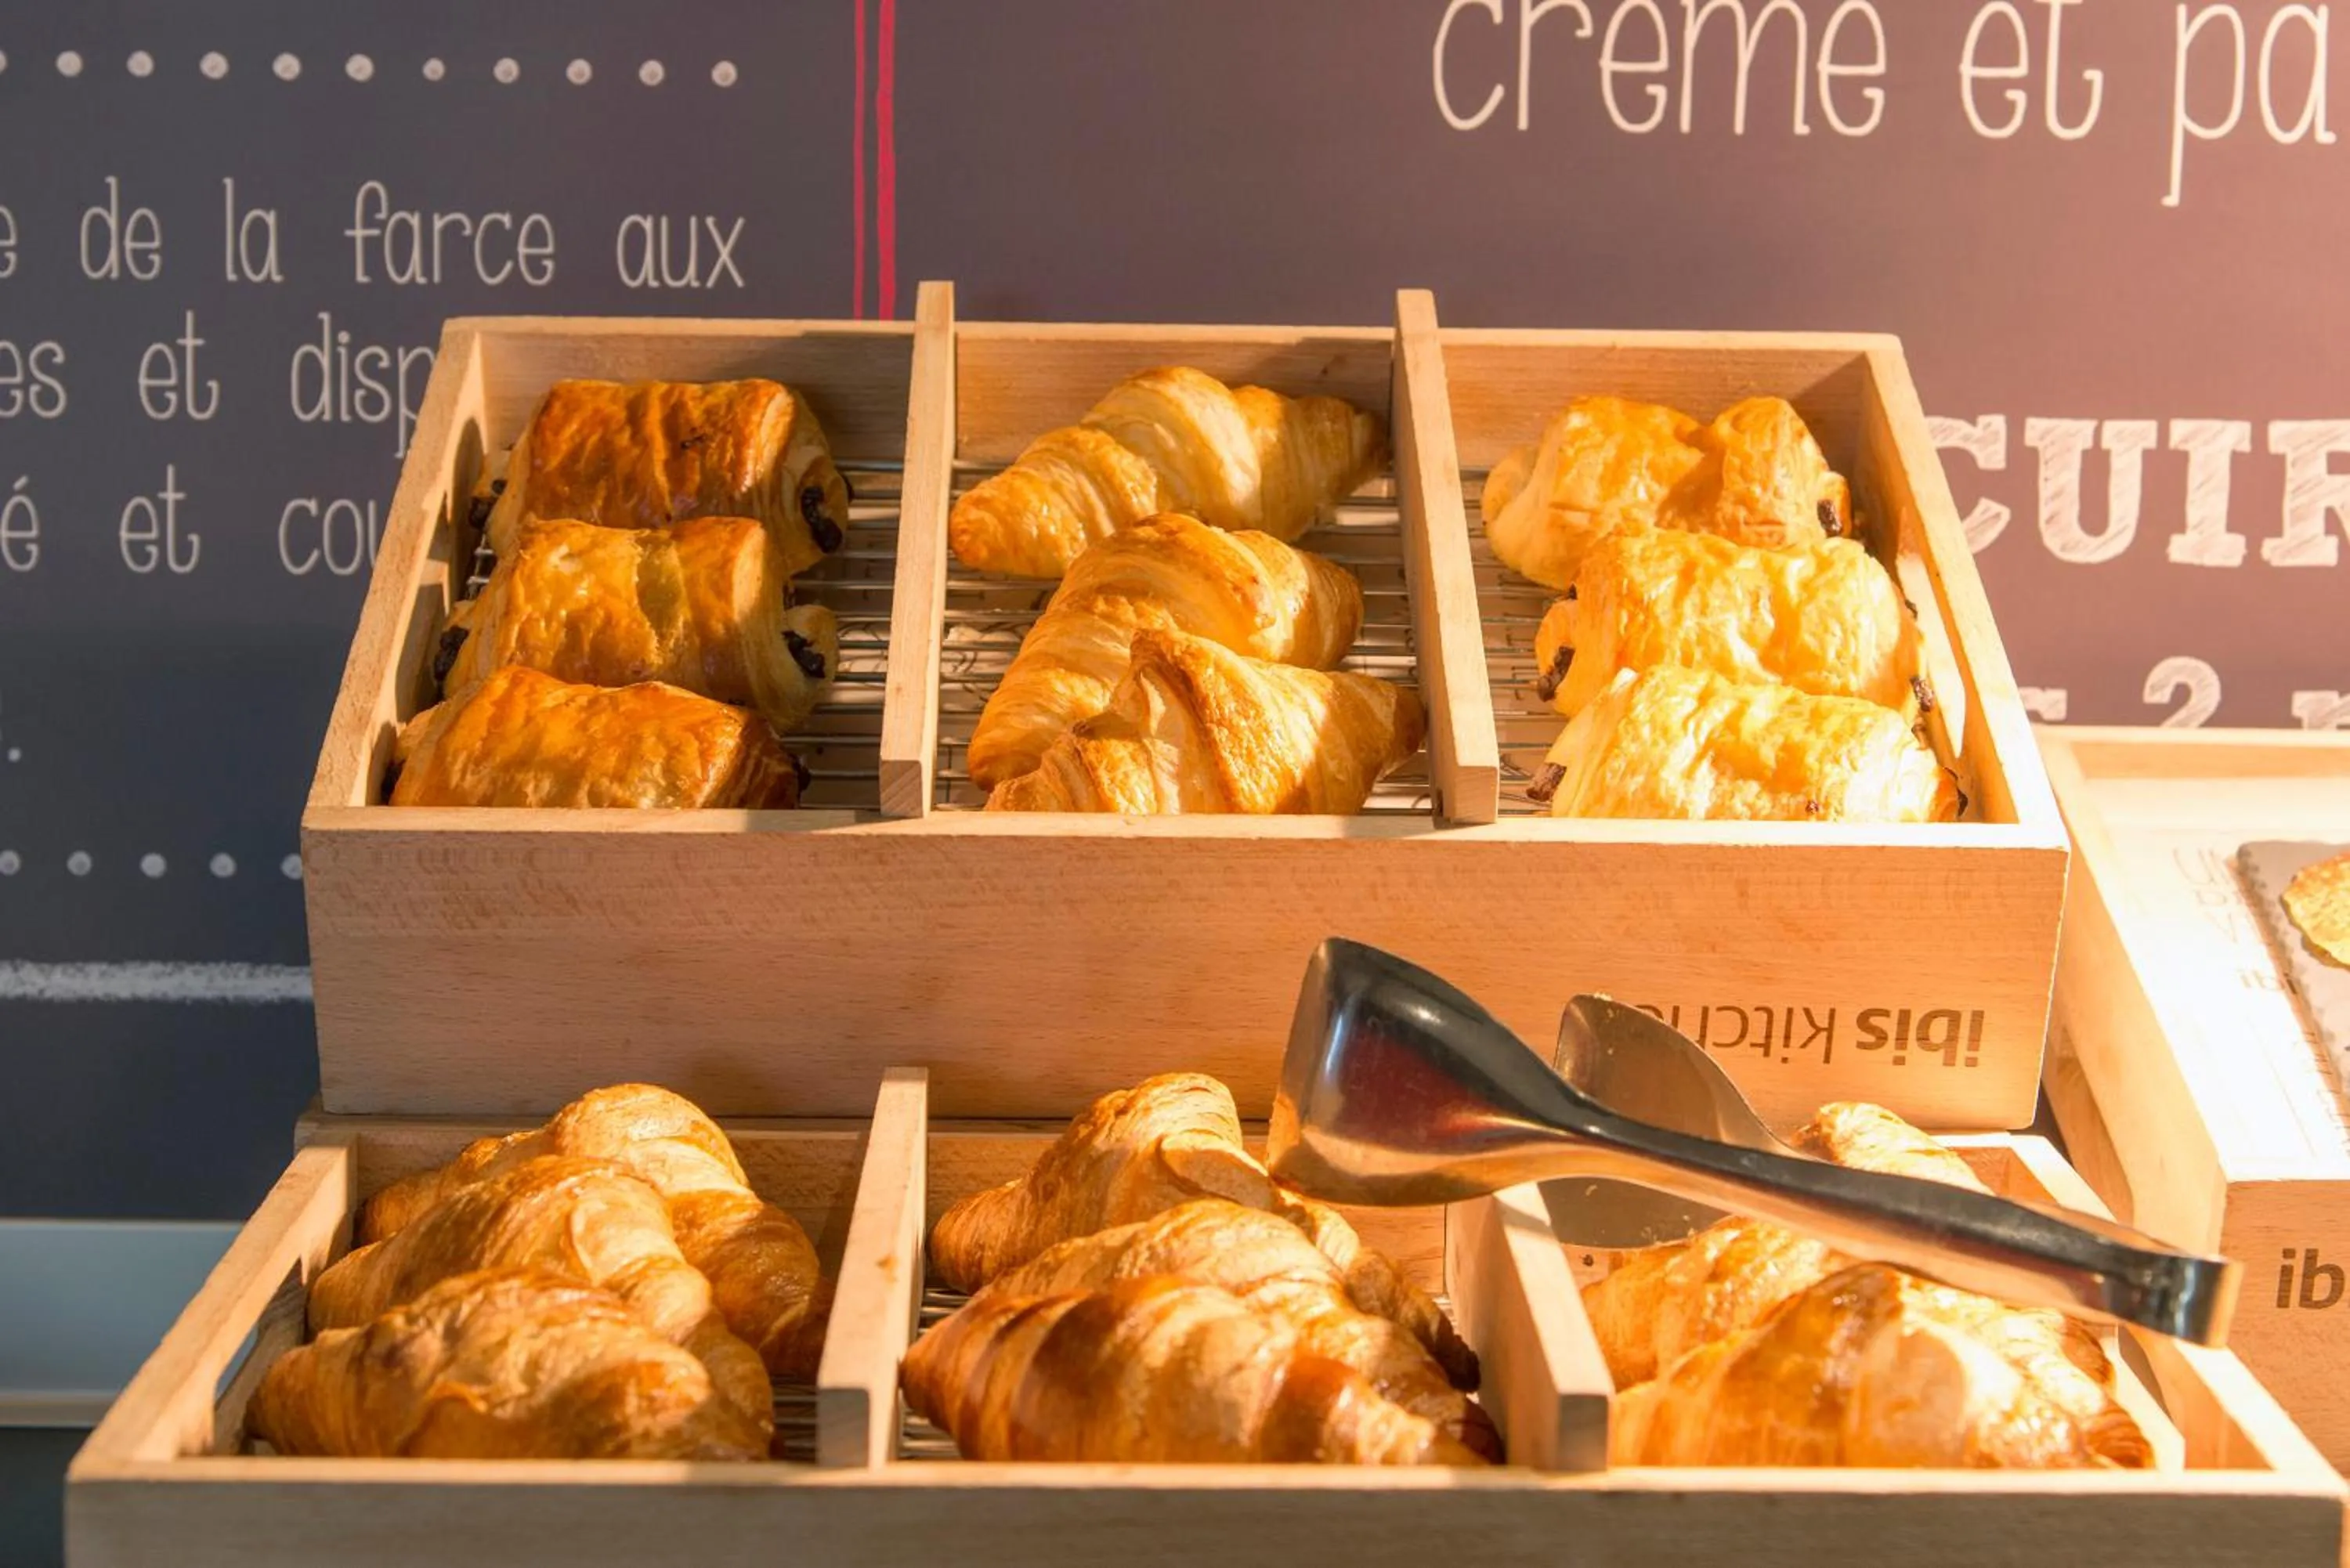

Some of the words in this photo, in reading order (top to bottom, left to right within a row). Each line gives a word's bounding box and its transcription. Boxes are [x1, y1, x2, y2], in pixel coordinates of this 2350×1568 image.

[1958, 0, 2104, 141] et
[2160, 3, 2337, 208] pa
[79, 175, 161, 280] de
[222, 177, 284, 283] la
[344, 179, 555, 286] farce
[616, 213, 745, 288] aux
[0, 340, 67, 419] es
[137, 309, 220, 421] et
[291, 311, 434, 458] disp
[0, 475, 39, 572] é
[118, 464, 201, 573] et
[1855, 1007, 1986, 1068] ibis
[2276, 1247, 2350, 1310] ib
